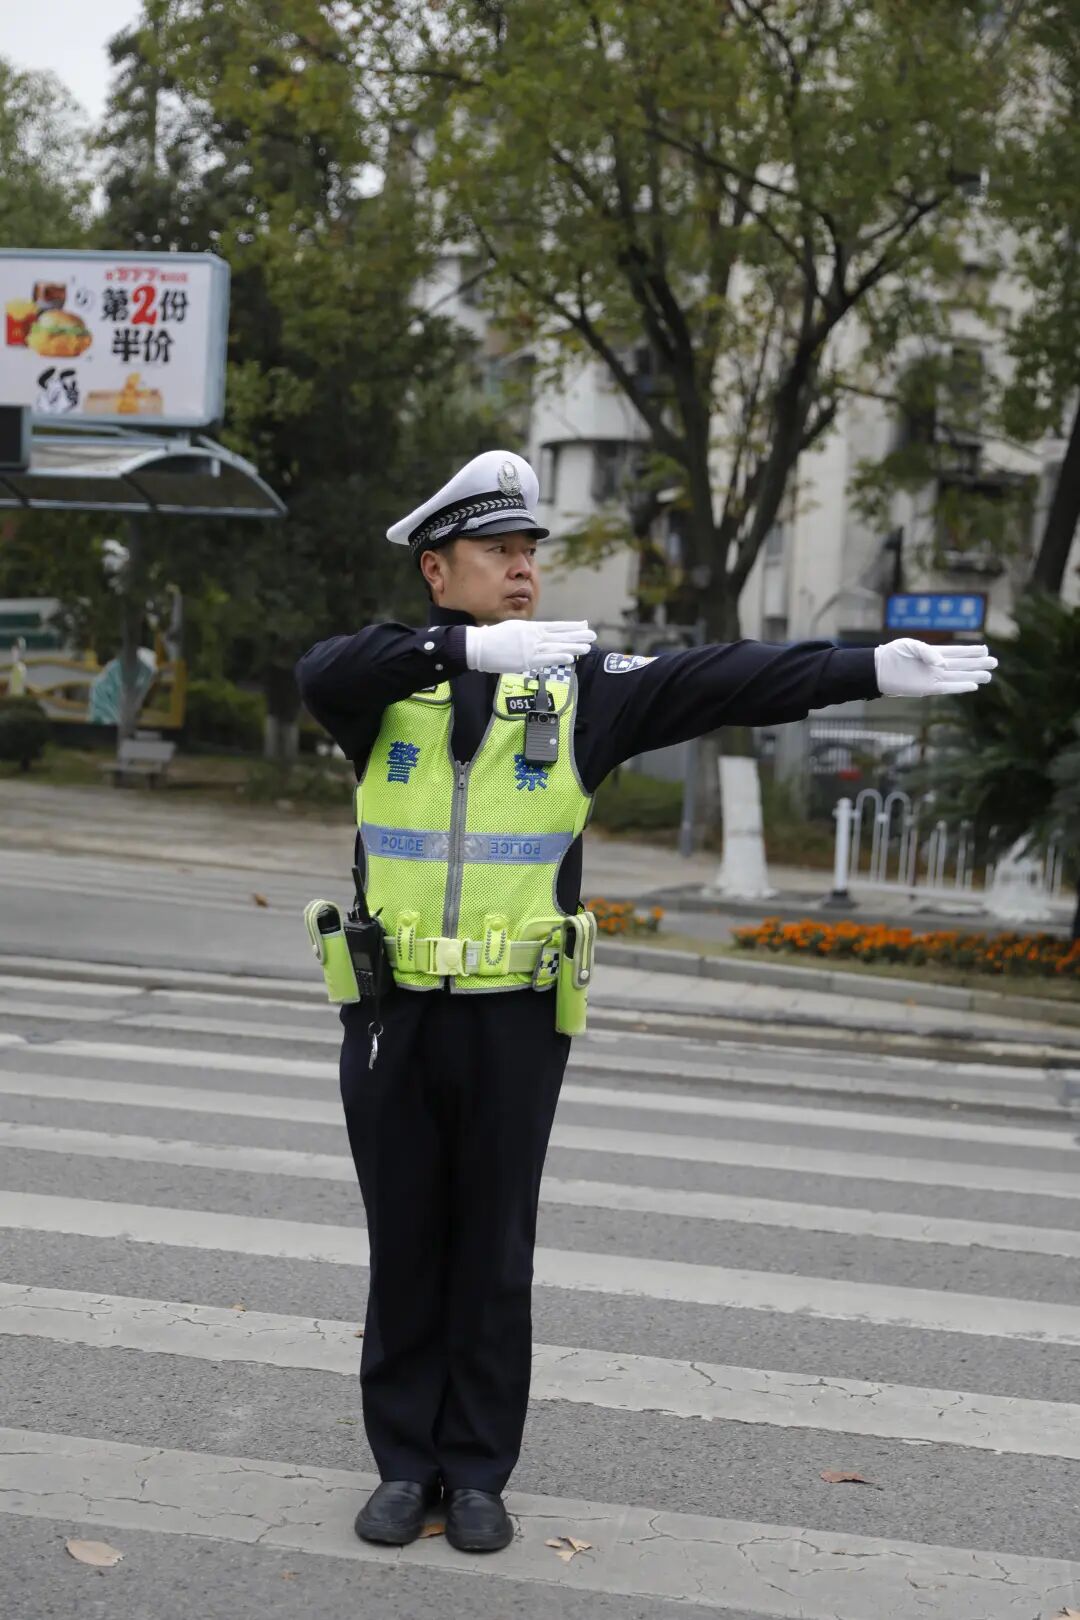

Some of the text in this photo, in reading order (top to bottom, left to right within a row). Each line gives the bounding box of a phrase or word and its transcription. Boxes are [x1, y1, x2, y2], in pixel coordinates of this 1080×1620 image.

[102, 285, 188, 325] 第2份
[112, 329, 173, 362] 半价
[387, 741, 420, 784] 警
[381, 835, 541, 855] POLICE POLICE
